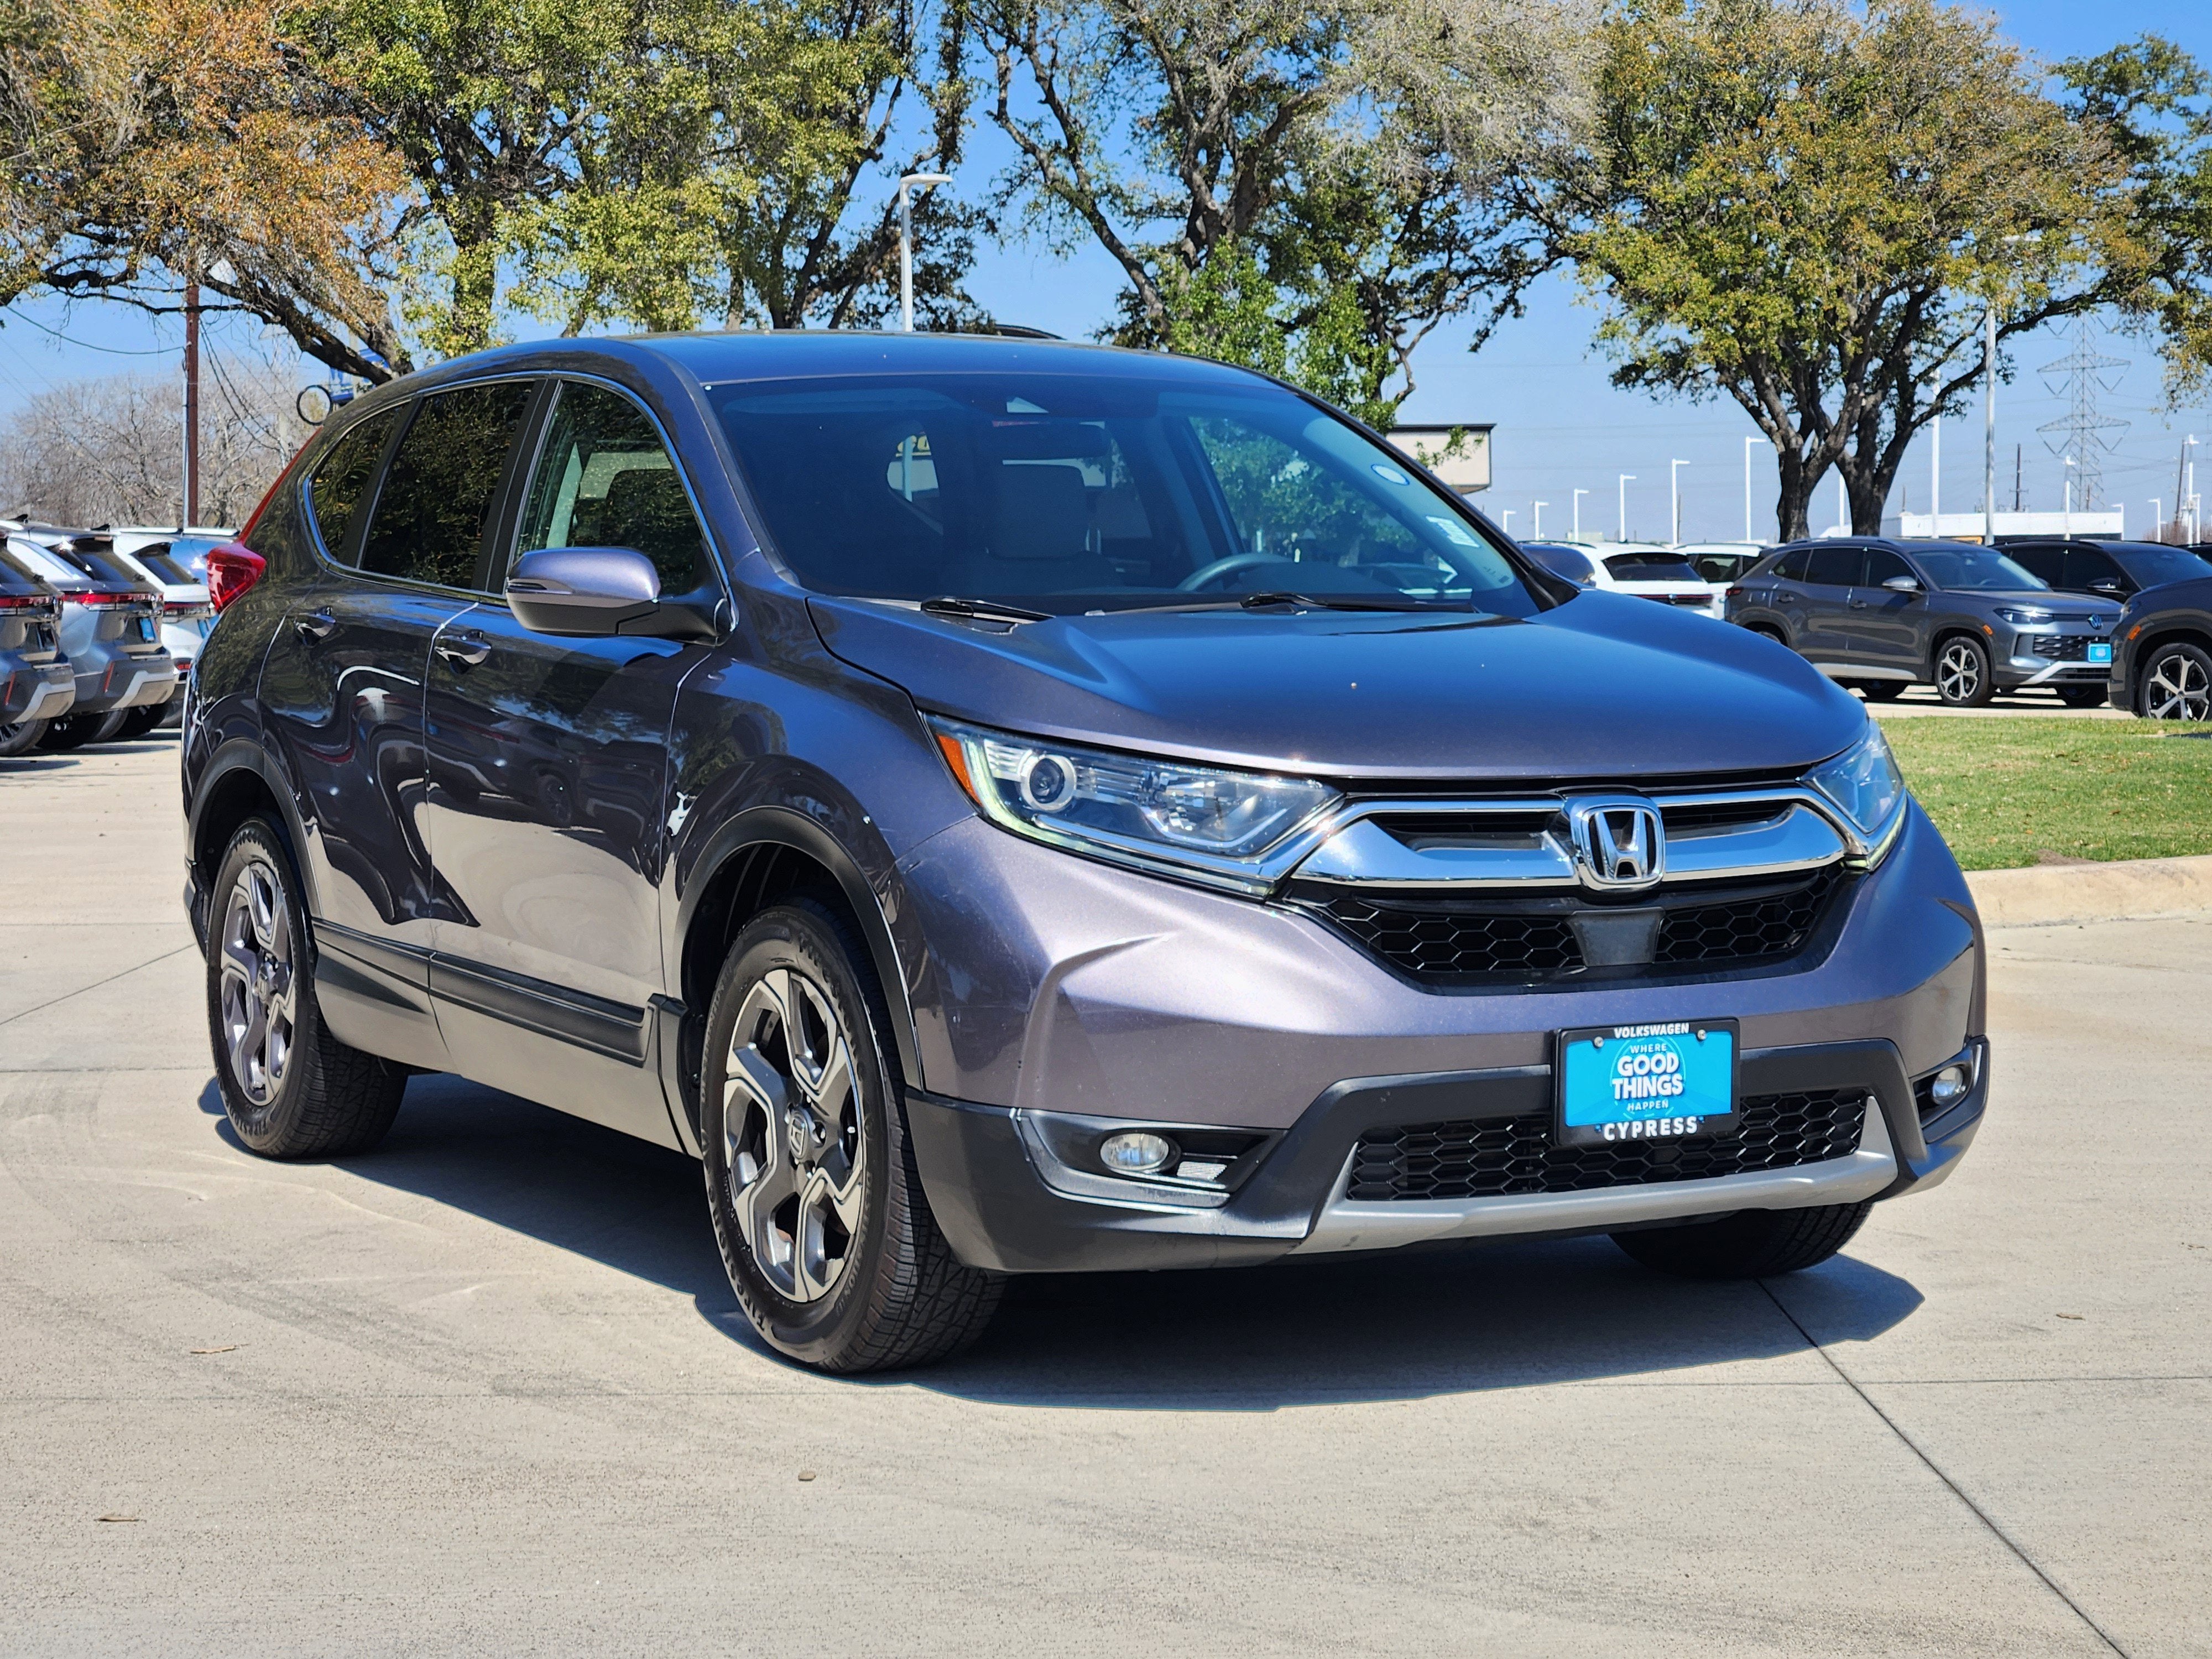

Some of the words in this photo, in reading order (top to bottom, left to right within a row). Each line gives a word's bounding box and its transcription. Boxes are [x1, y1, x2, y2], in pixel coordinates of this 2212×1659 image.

[1614, 1022, 1689, 1039] VOLKSWAGEN
[1630, 1043, 1667, 1053] WHERE
[1617, 1052, 1679, 1077] GOOD
[1612, 1073, 1683, 1099] THINGS
[1627, 1099, 1669, 1111] HAPPEN
[1604, 1116, 1697, 1141] CYPRESS
